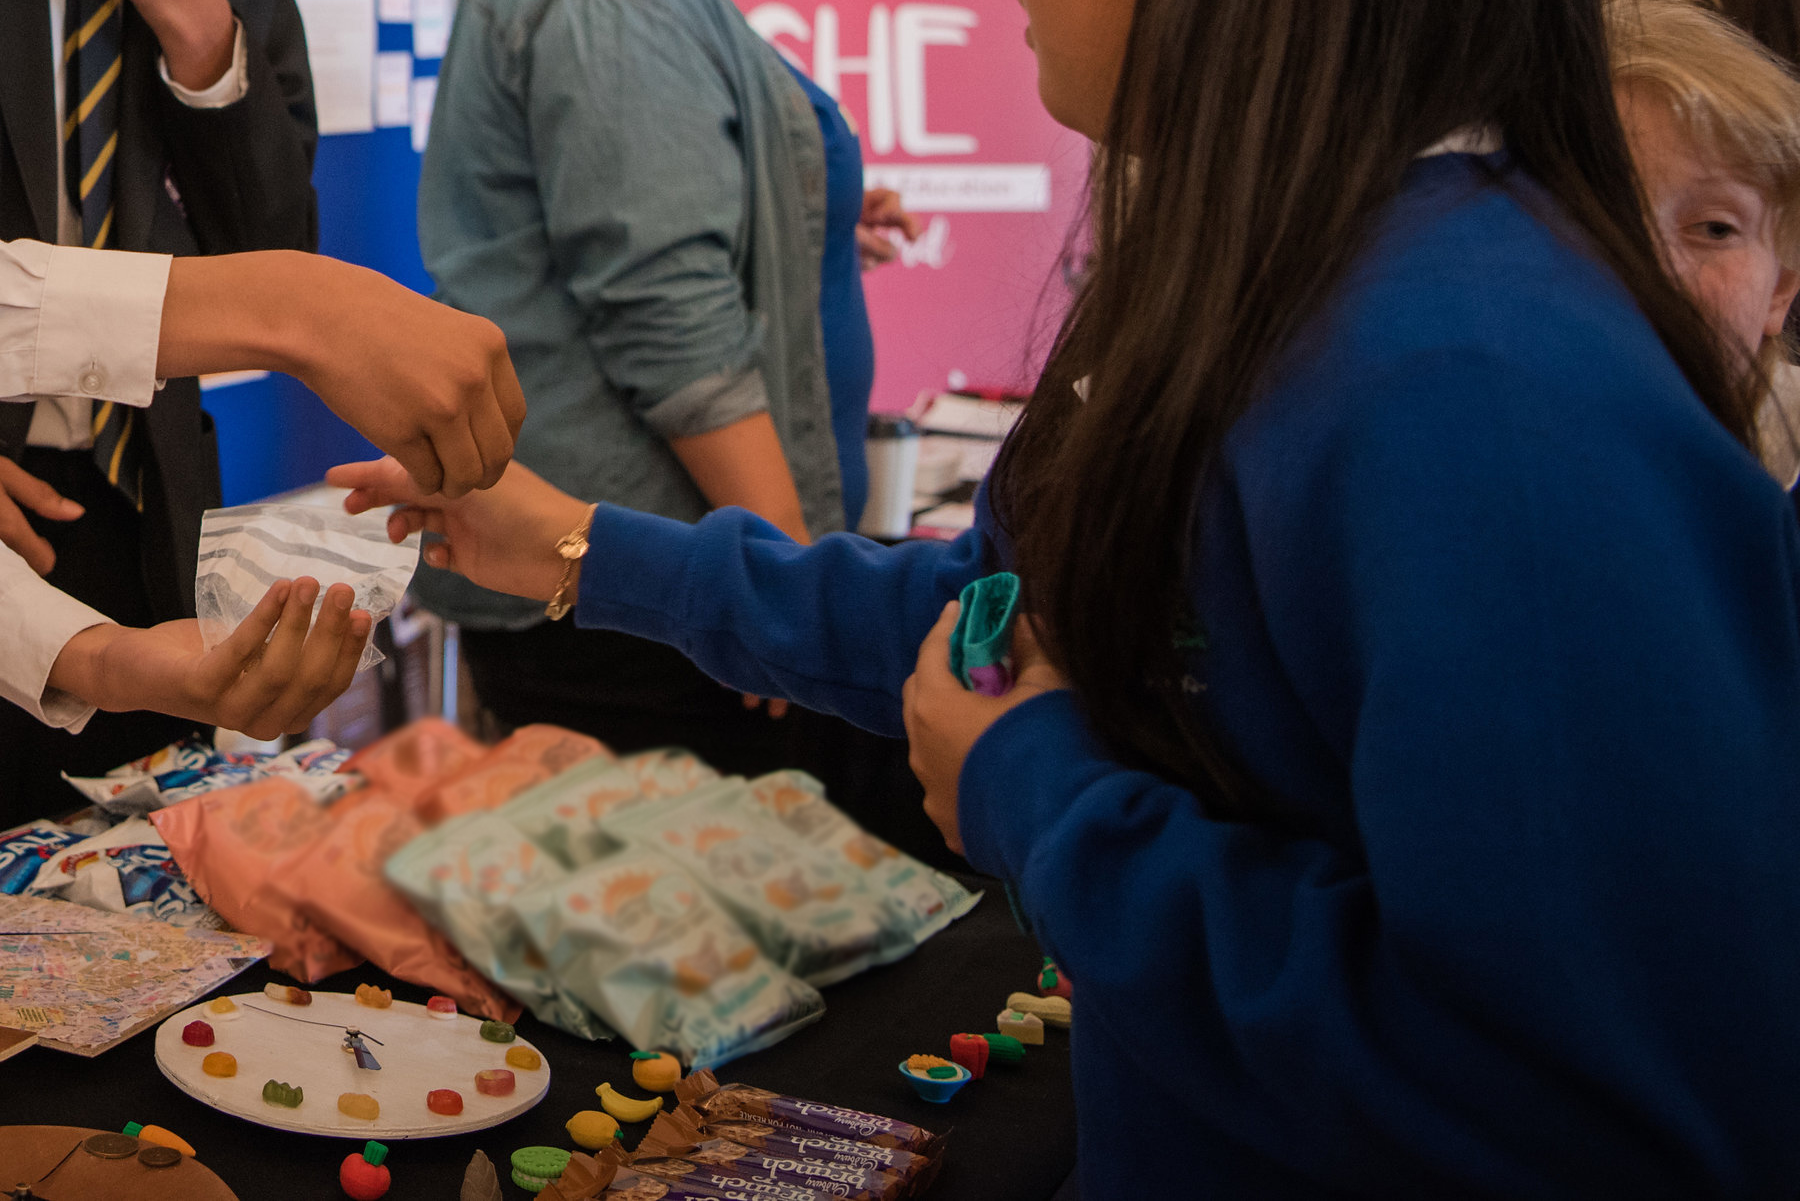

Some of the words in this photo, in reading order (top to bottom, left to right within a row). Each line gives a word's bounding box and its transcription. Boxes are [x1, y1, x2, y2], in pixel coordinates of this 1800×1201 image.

[740, 1110, 769, 1126] RESALE
[795, 1101, 894, 1131] brunch
[834, 1117, 877, 1137] Cadbury
[790, 1135, 895, 1166] brunch
[833, 1151, 878, 1171] Cadbury
[762, 1157, 867, 1190] brunch
[710, 1174, 816, 1201] brunch
[805, 1177, 850, 1198] Cadbury
